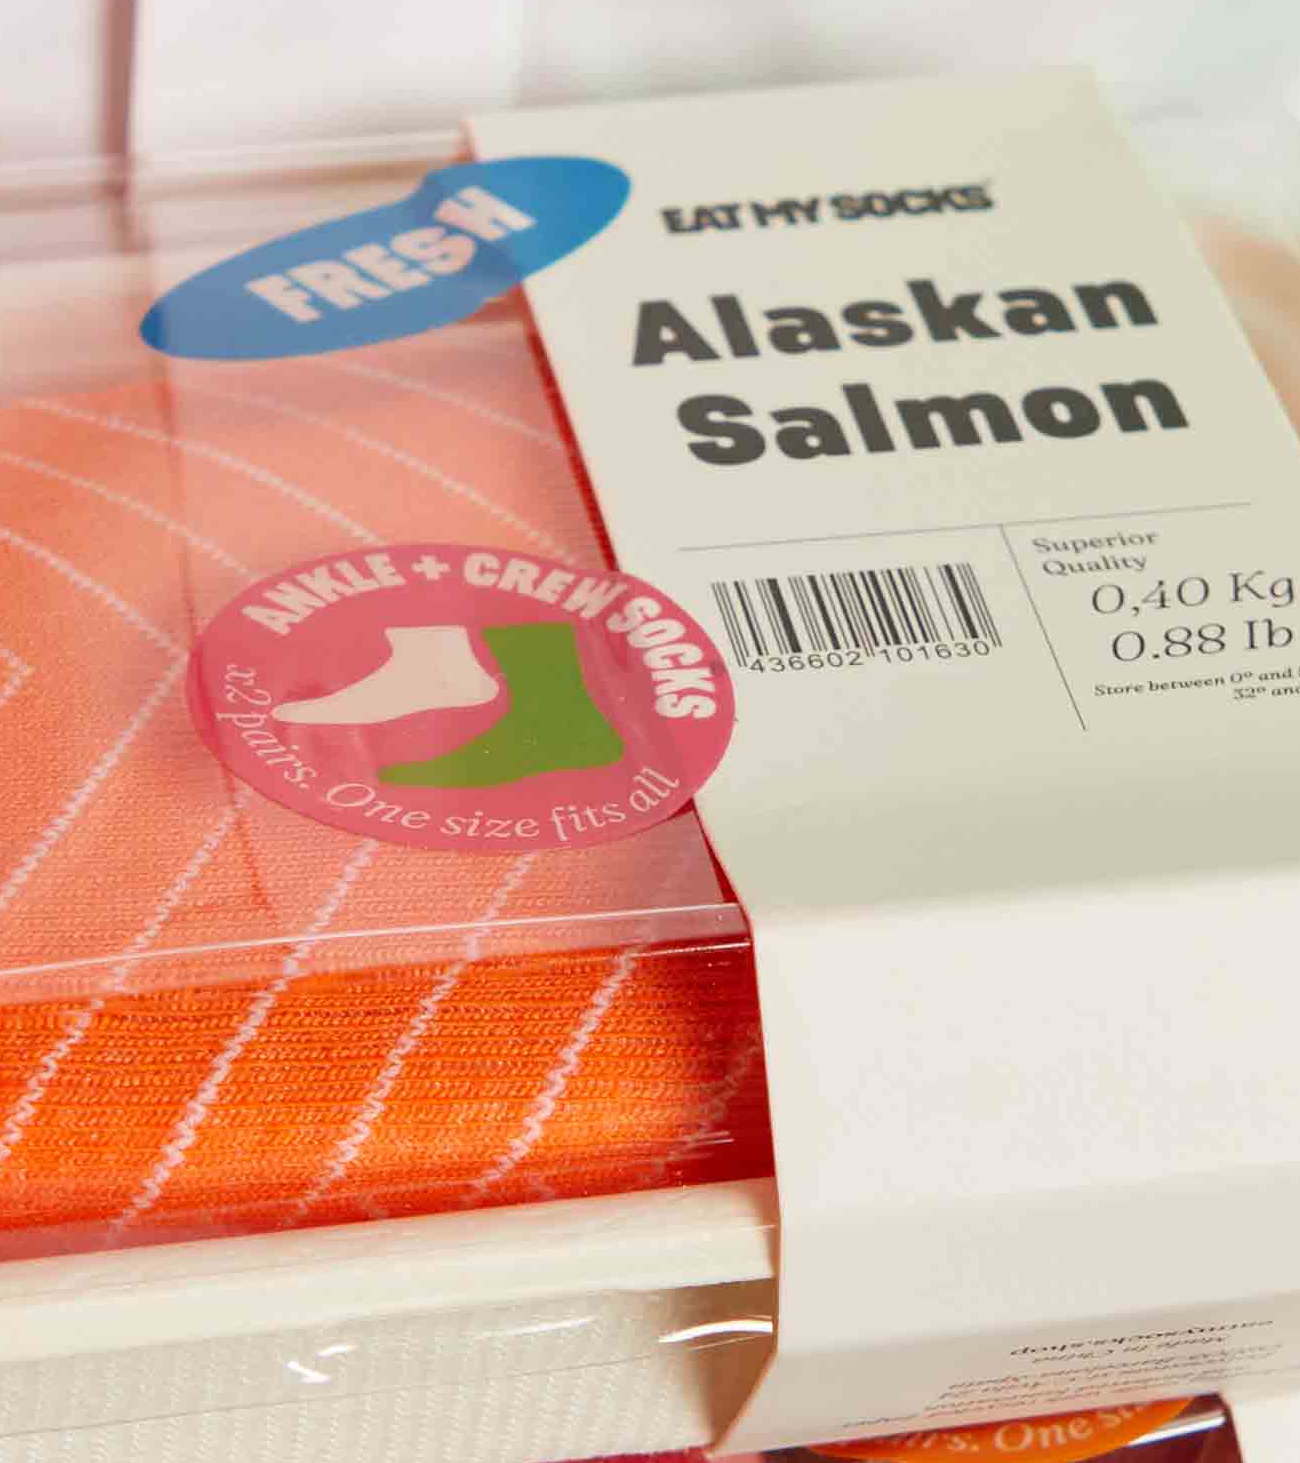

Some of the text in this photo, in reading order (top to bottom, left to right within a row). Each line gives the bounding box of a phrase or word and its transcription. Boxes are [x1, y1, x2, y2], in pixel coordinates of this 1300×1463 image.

[661, 184, 992, 235] EAT MY SOCKS
[246, 186, 536, 322] FRESH
[633, 279, 1158, 366] Alaskan
[676, 380, 1188, 466] Salmon
[1032, 530, 1160, 555] Superior
[1042, 554, 1148, 576] Quality
[1229, 570, 1295, 608] Kg
[242, 552, 406, 635] ANKLE
[463, 552, 628, 618] CREW
[606, 596, 716, 720] SOCKS
[1112, 623, 1226, 662] 0.88
[1094, 683, 1144, 698] Store
[1149, 675, 1225, 693] between
[1258, 667, 1292, 681] and
[215, 663, 680, 842] x2 pairs. One size fits all
[994, 1420, 1093, 1453] One
